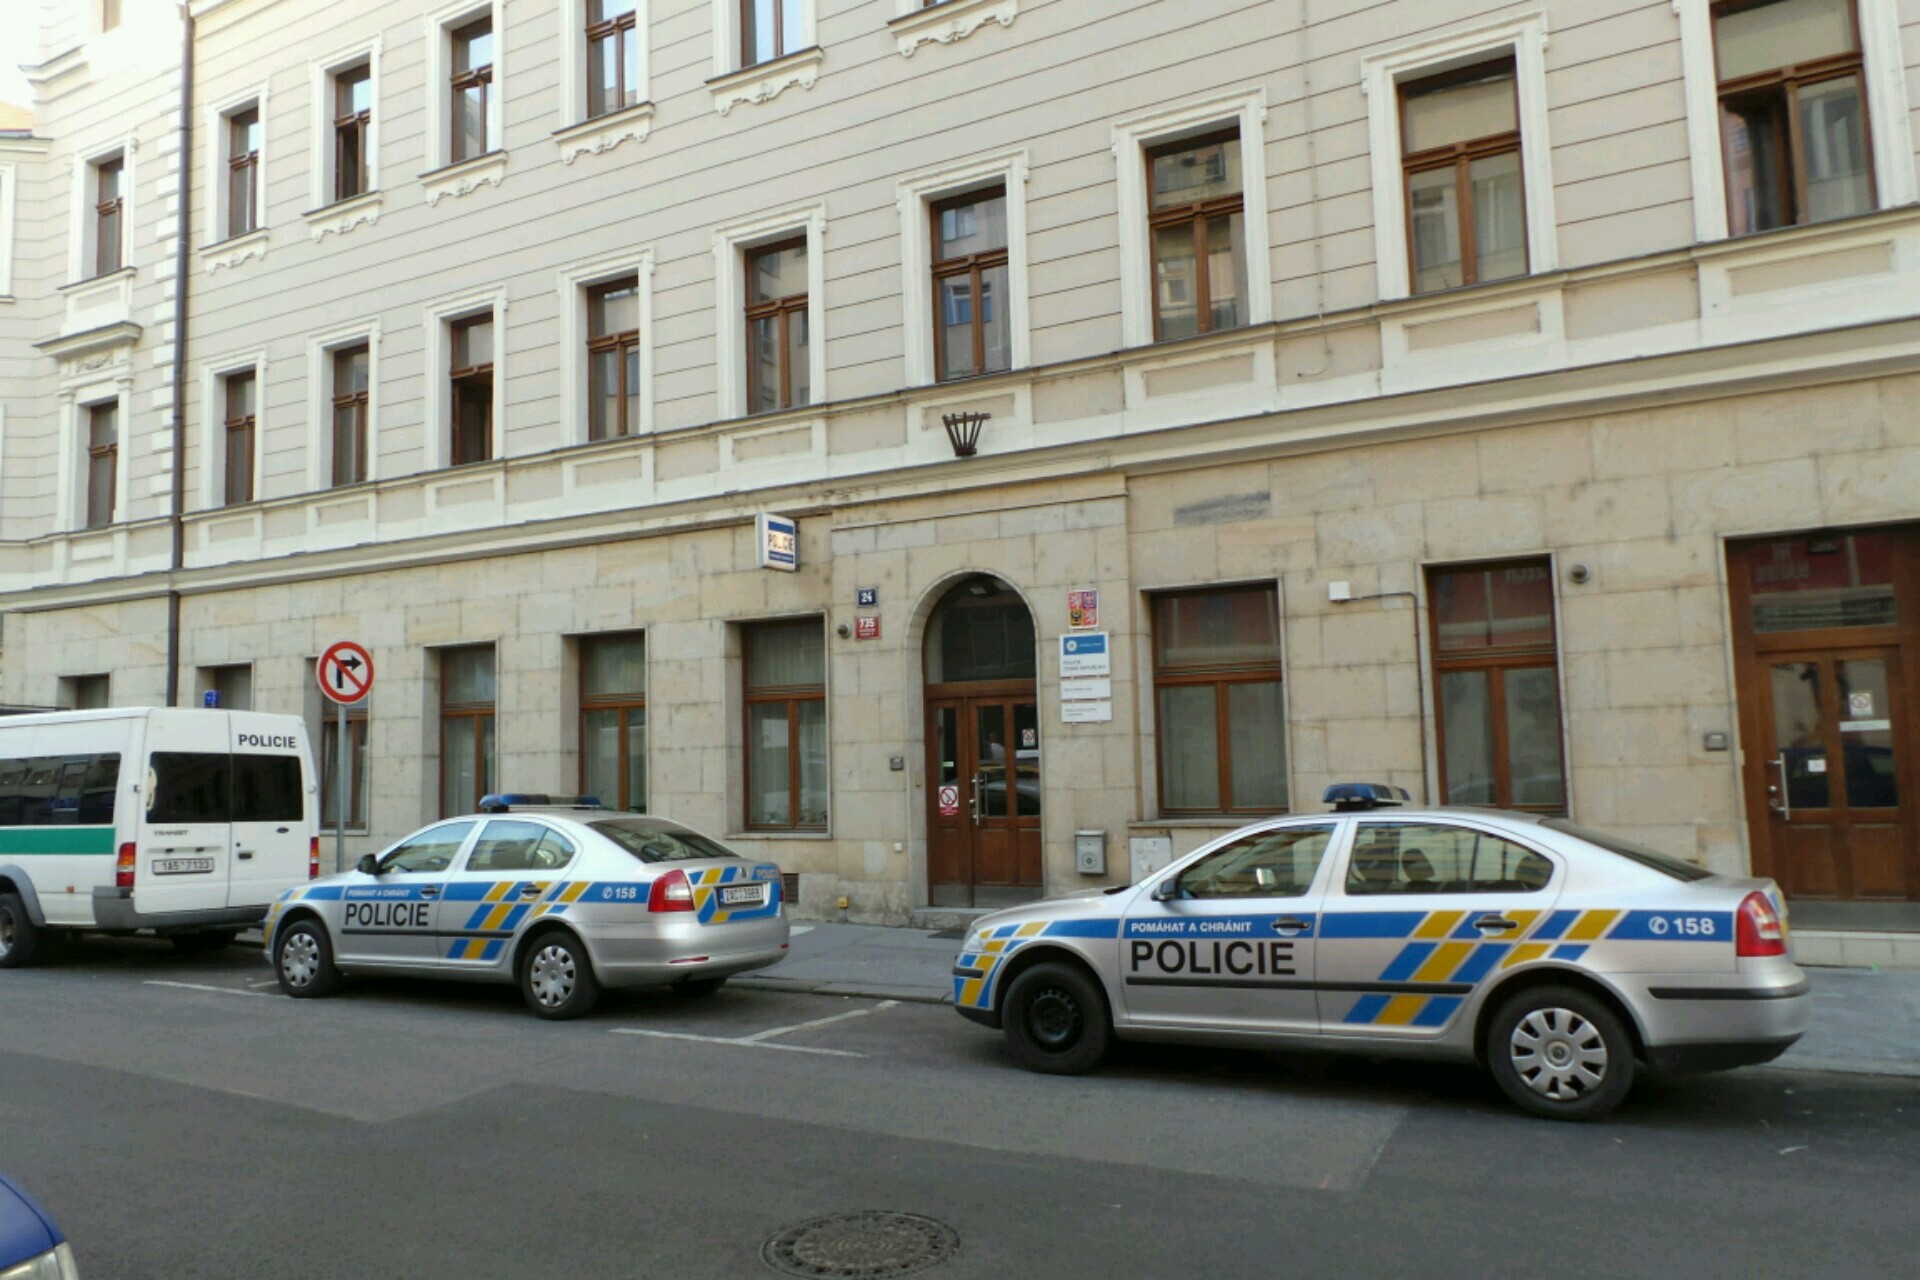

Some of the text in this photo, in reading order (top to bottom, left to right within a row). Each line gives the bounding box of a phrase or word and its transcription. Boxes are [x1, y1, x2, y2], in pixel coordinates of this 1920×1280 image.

[861, 592, 873, 603] 24
[238, 734, 296, 748] POLICIE
[615, 887, 637, 899] 158
[345, 902, 429, 926] POLICIE
[1131, 920, 1252, 933] POMÁHAT A CHRÁNIT
[1673, 917, 1715, 936] 158
[1131, 940, 1296, 975] POLICIE
